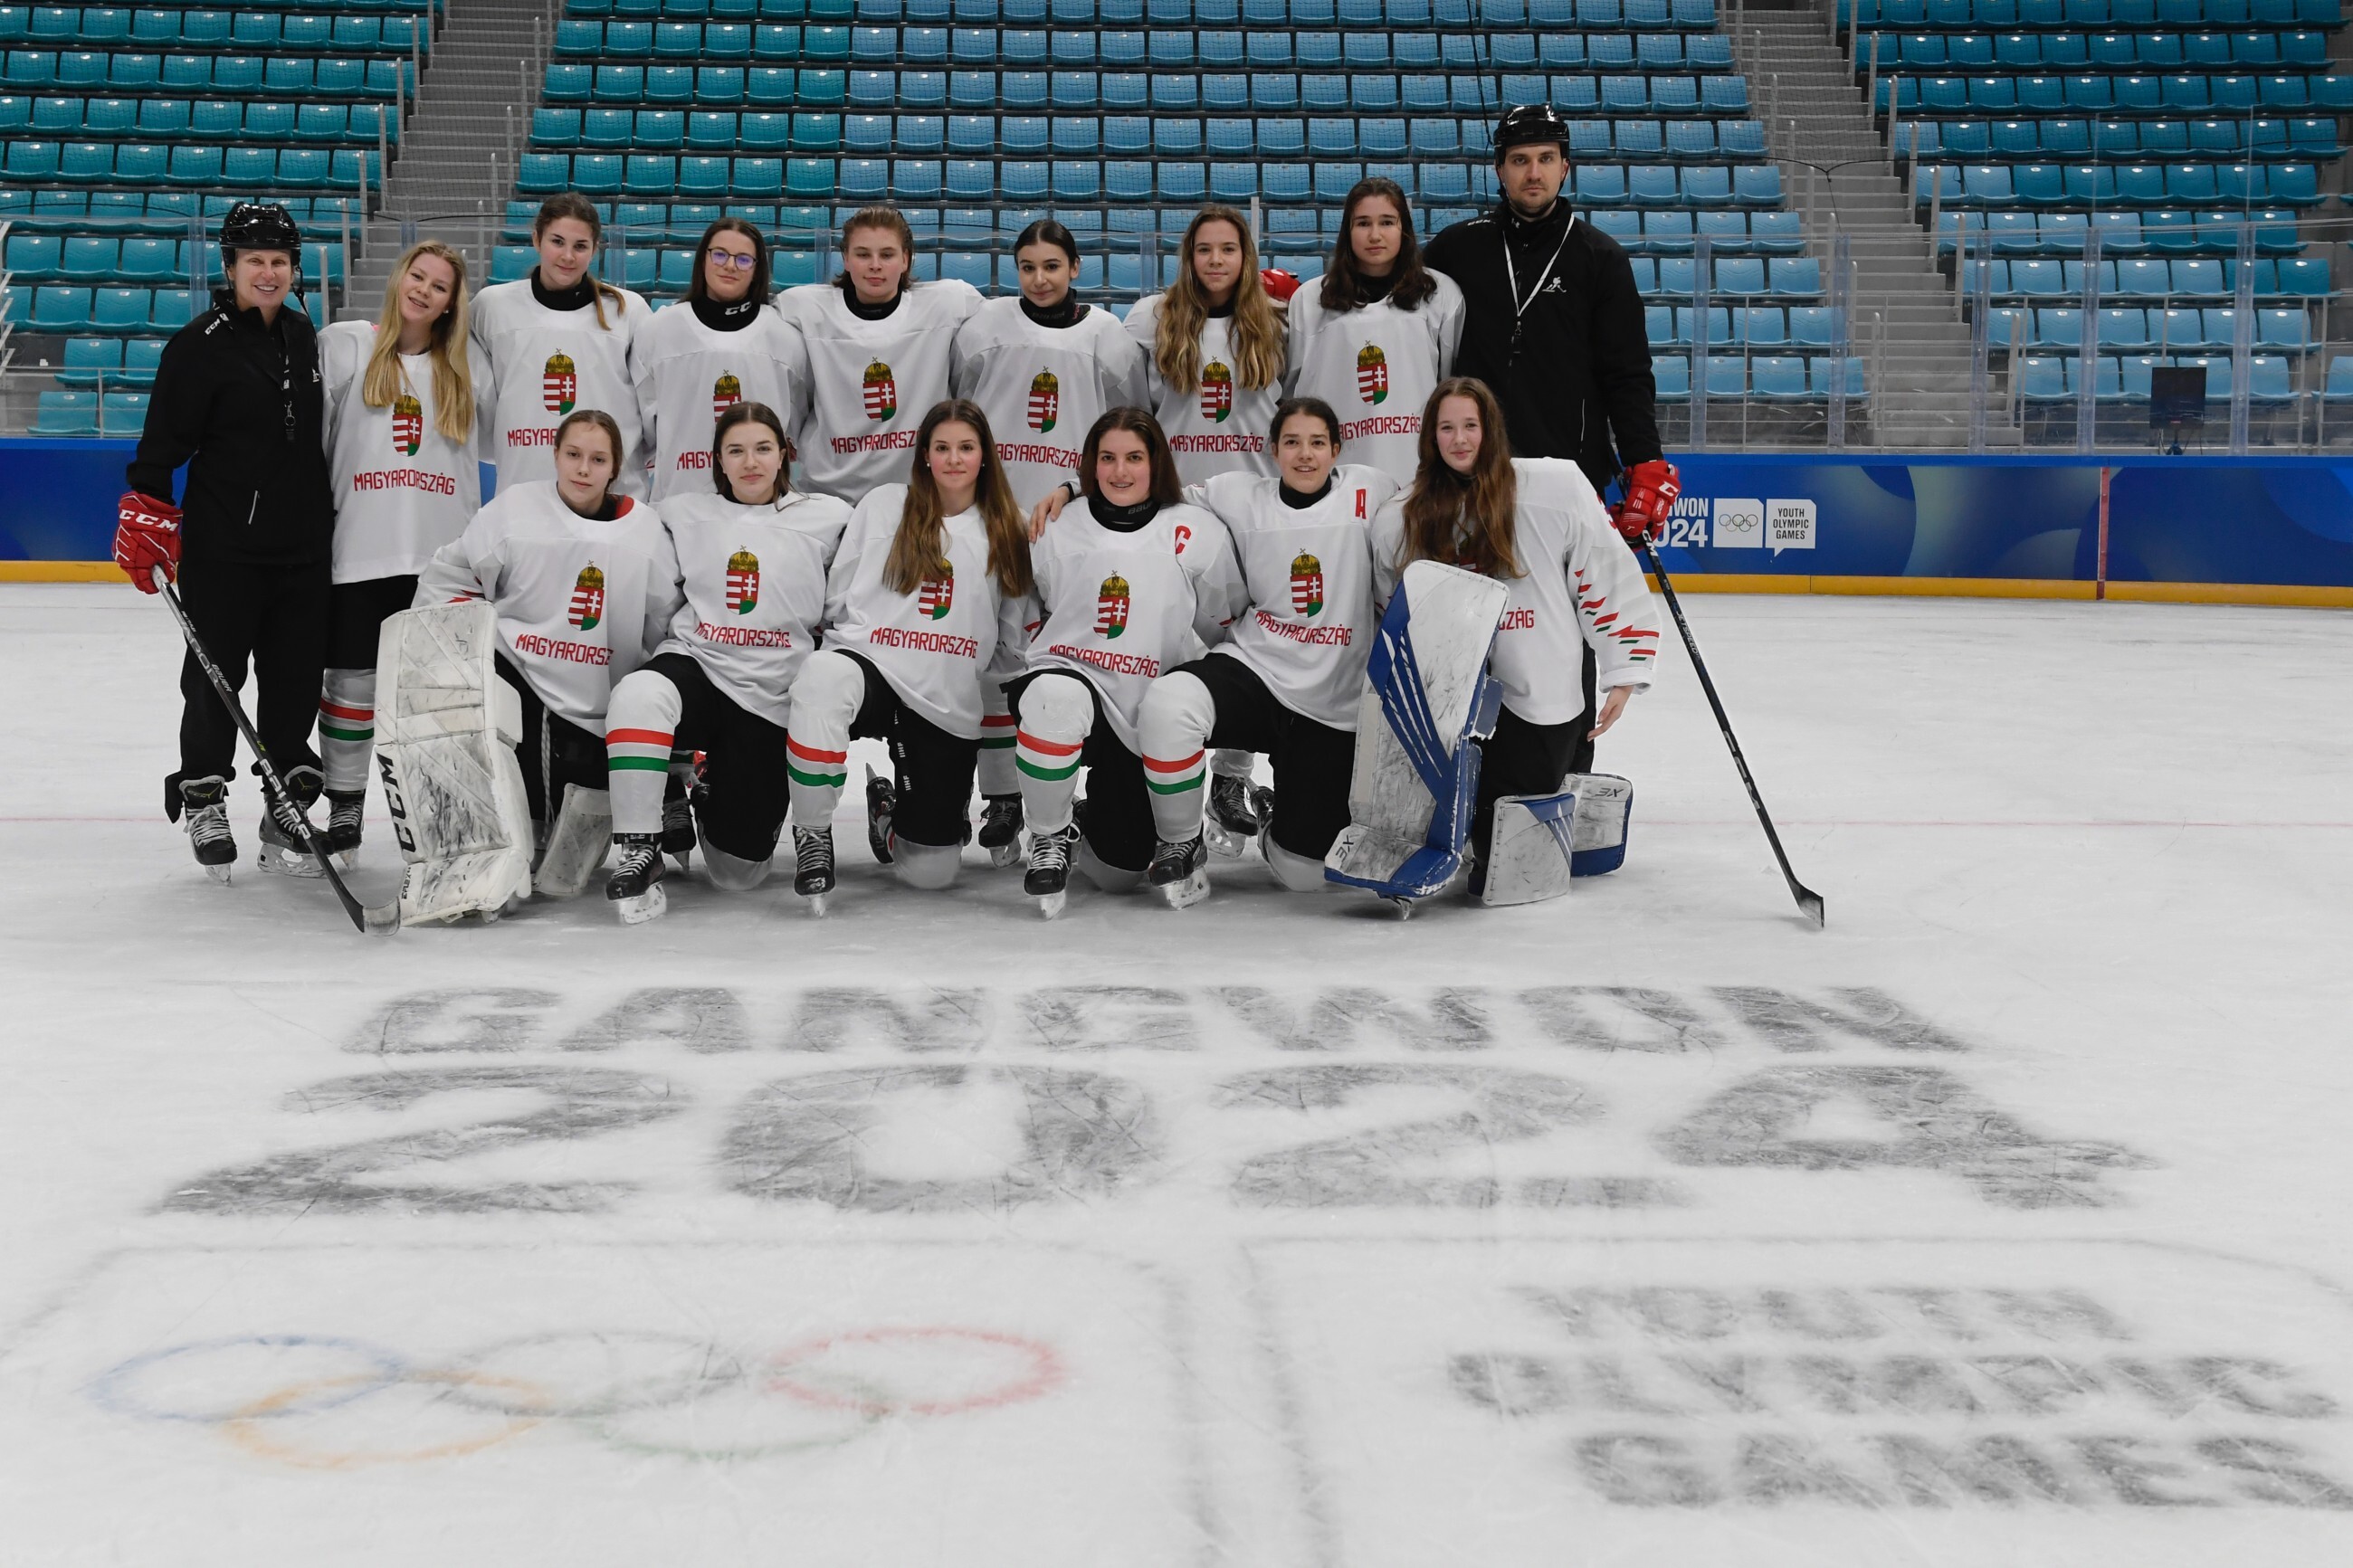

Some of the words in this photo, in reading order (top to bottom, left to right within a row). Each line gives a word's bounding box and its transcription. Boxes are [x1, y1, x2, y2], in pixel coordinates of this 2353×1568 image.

[205, 318, 221, 335] CCM
[830, 429, 919, 454] MAGYARORSZ
[1169, 432, 1264, 453] MAGYARORSZÁG
[354, 468, 455, 496] MAGYARORSZÁG
[1355, 489, 1367, 519] A
[1777, 508, 1805, 518] YOUTH
[119, 508, 179, 532] CCM
[1772, 518, 1809, 529] OLYMPIC
[1176, 525, 1191, 555] C
[1776, 530, 1805, 540] GAMES
[1255, 610, 1353, 646] MAGYARORSZÁG
[212, 664, 233, 692] BAUER
[376, 753, 416, 853] CCM
[339, 986, 1977, 1053] GANGWON
[143, 1064, 2167, 1215] 2024
